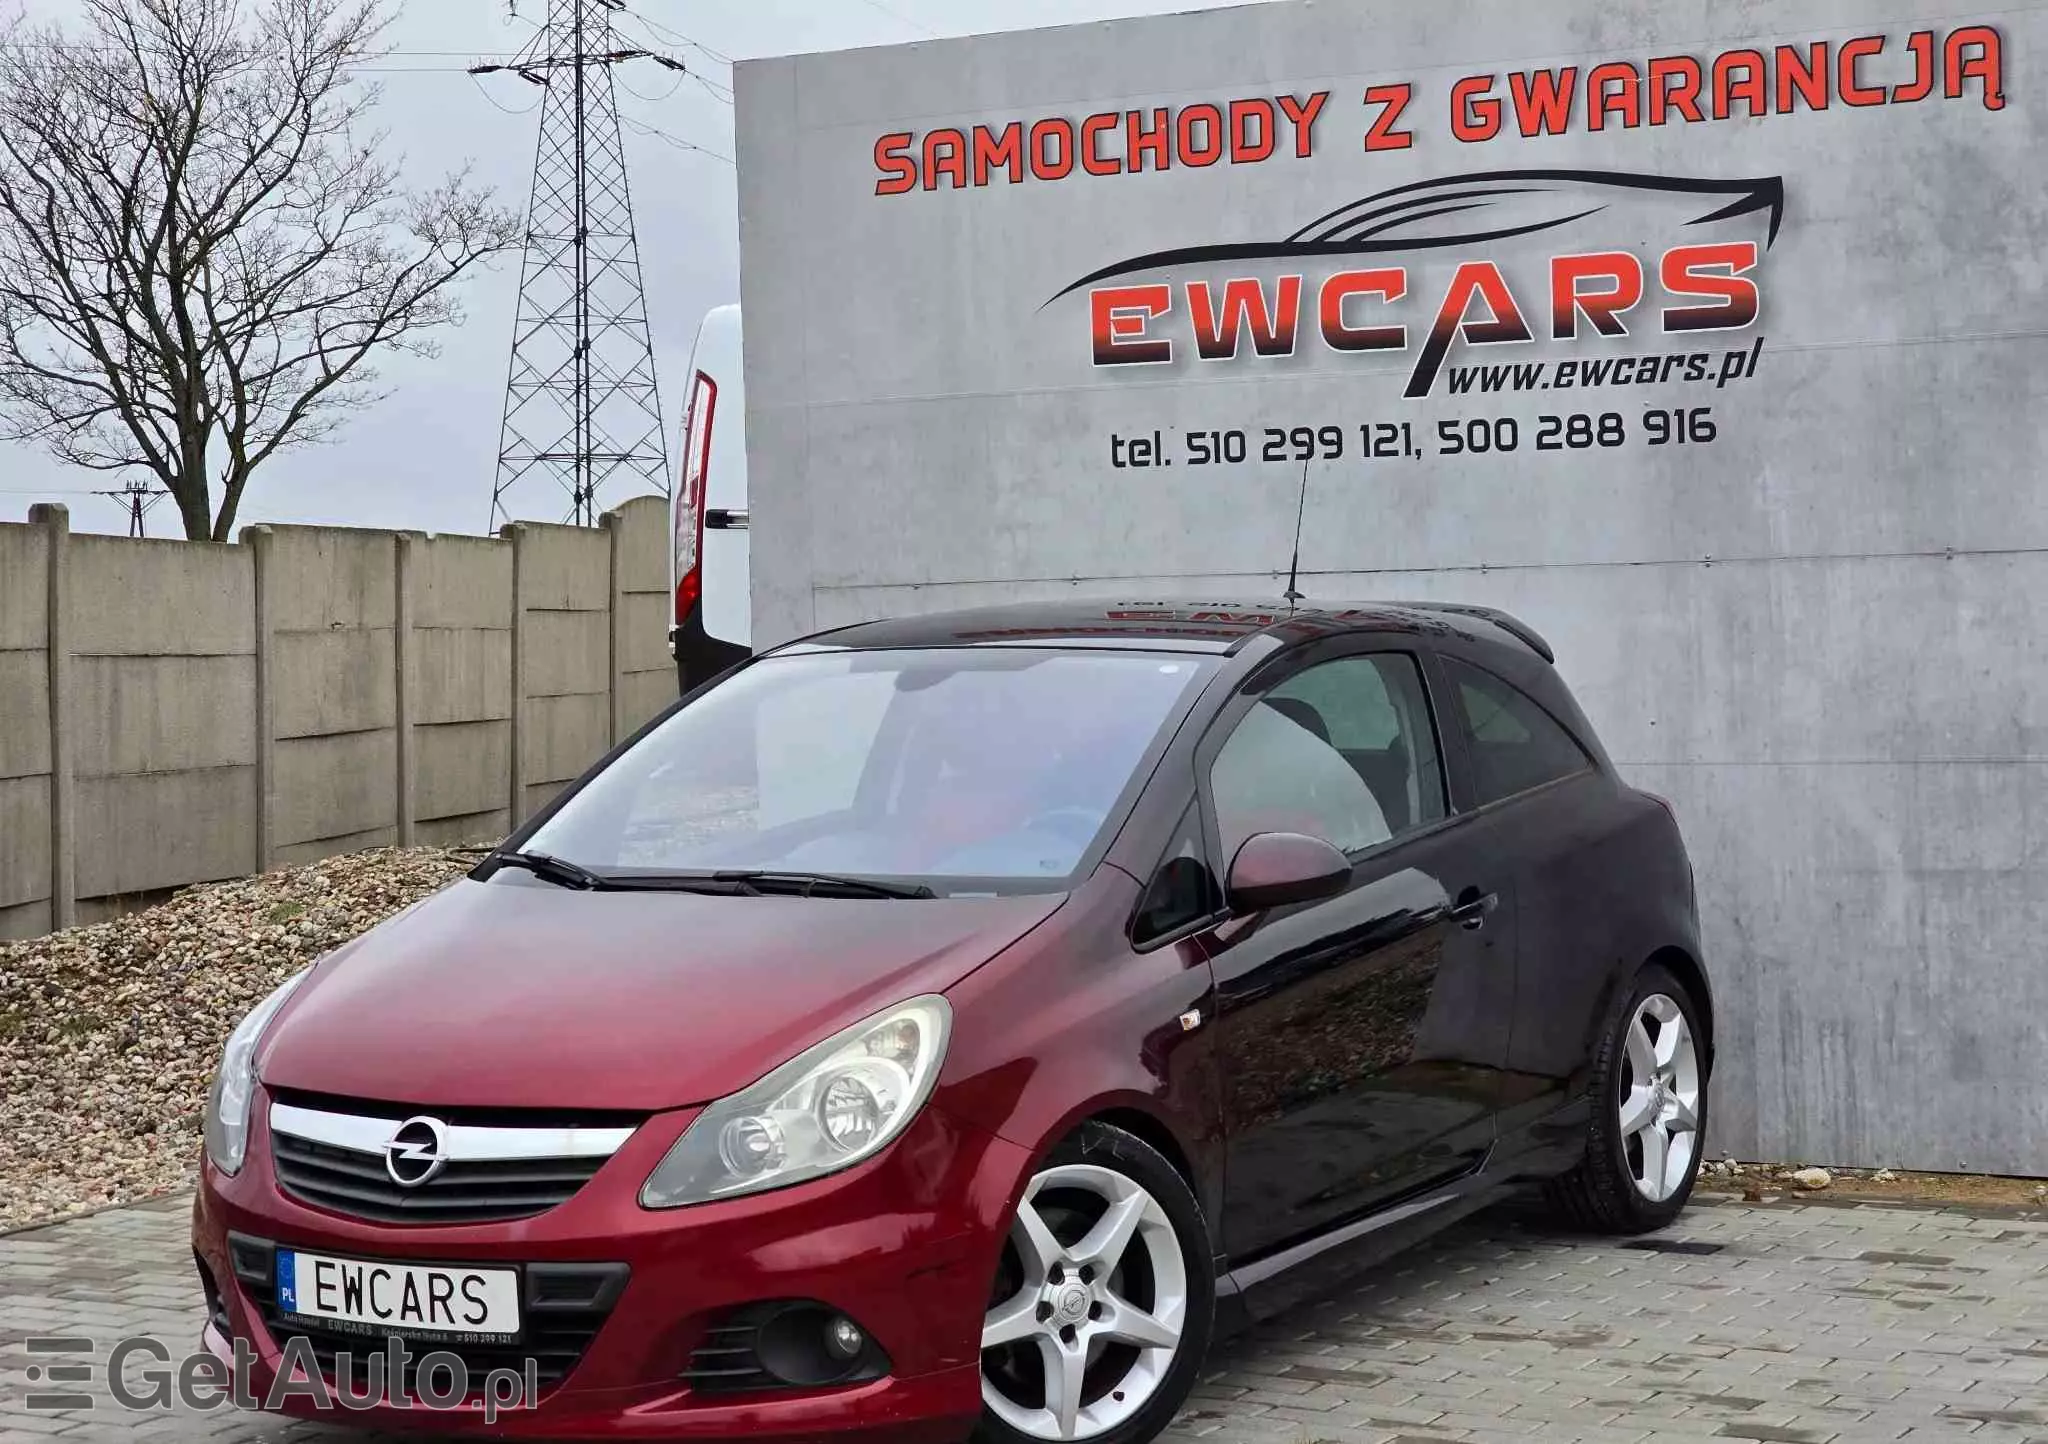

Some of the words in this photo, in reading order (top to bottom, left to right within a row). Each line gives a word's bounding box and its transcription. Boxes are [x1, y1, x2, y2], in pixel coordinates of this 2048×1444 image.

[874, 92, 1330, 196] SAMOCHODY
[1364, 83, 1413, 153] Z
[1450, 25, 2006, 144] GWARANCJĄ
[1089, 241, 1761, 399] EWCARS
[1448, 337, 1764, 394] www.ewcars.pl
[1111, 430, 1172, 468] tel.
[1186, 430, 1246, 465] 510
[1262, 425, 1343, 462] 299
[1359, 422, 1422, 460] 121,
[1438, 417, 1519, 456] 500
[1535, 412, 1626, 451] 288
[1641, 407, 1718, 447] 916
[282, 1287, 295, 1303] PL
[315, 1260, 489, 1325] EWCARS
[328, 1320, 373, 1336] EWCARS
